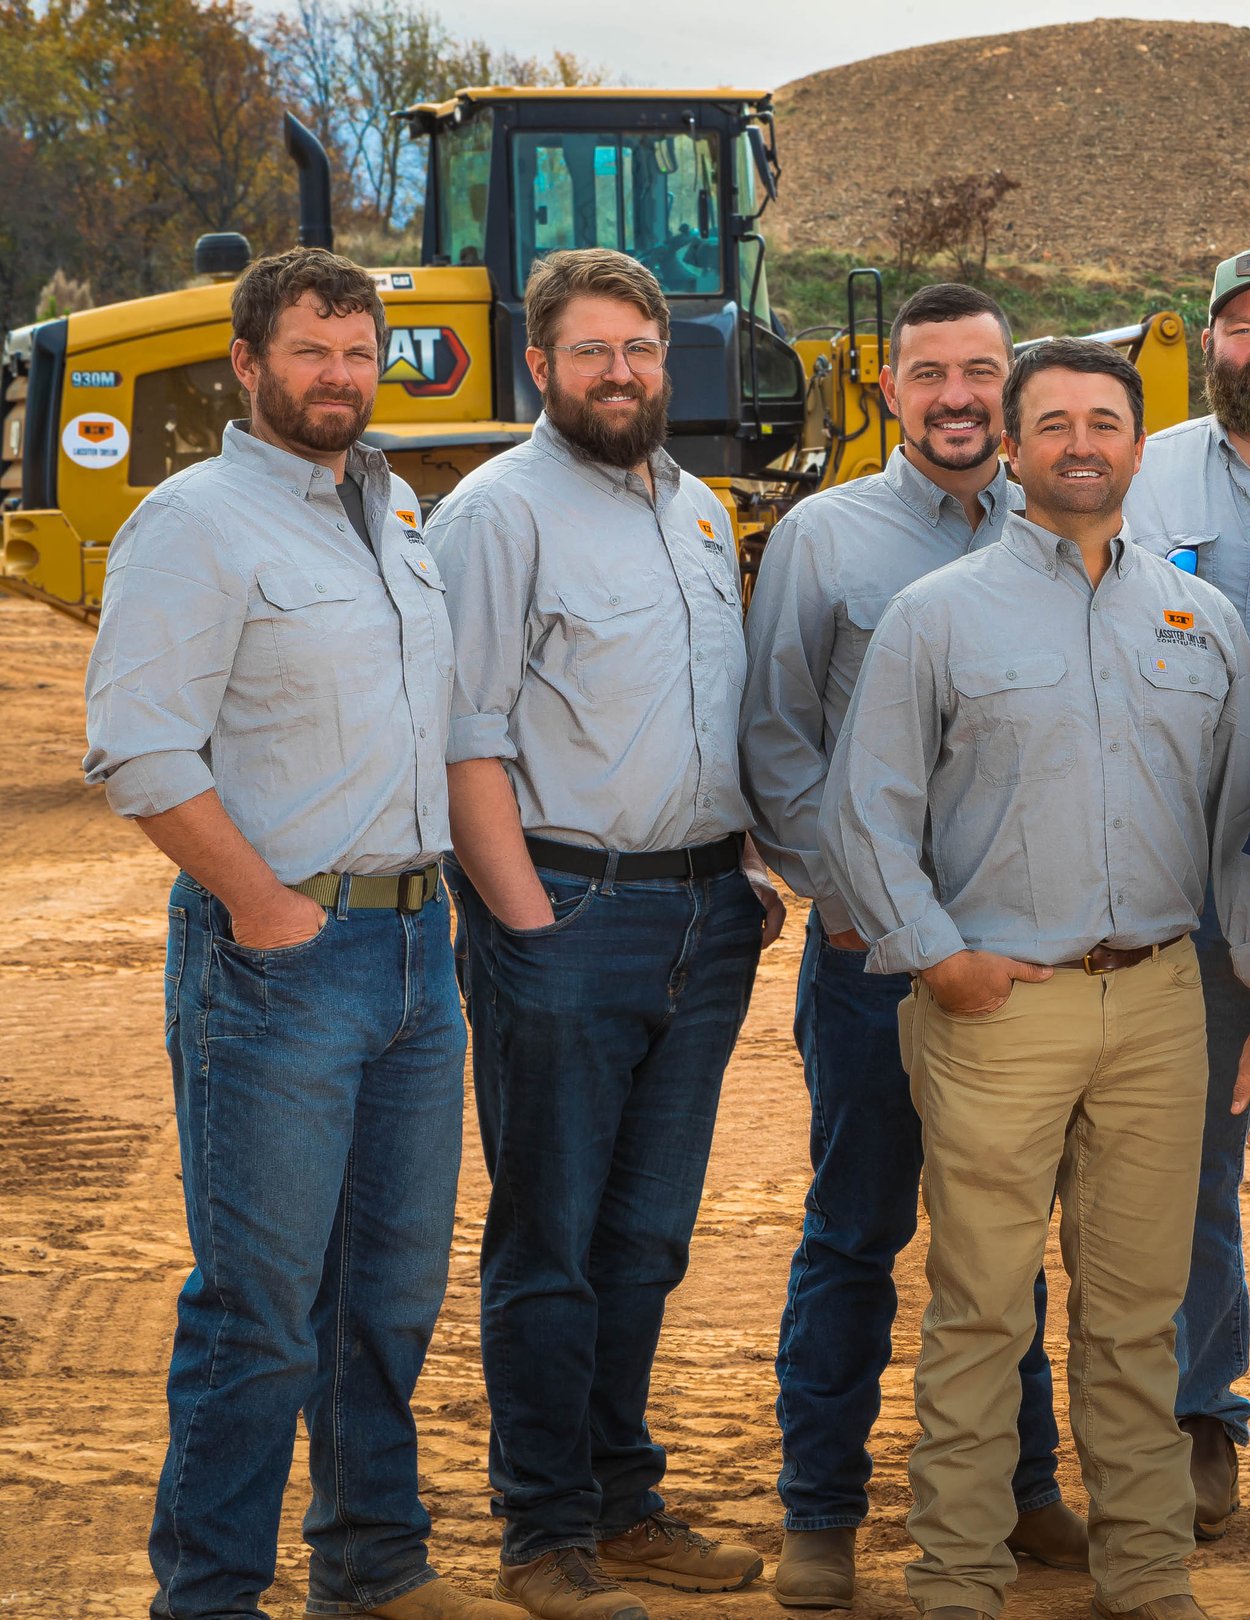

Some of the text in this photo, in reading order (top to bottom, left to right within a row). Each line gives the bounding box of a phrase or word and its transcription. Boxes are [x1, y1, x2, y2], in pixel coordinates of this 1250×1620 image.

[386, 328, 442, 381] AT
[72, 371, 116, 388] 930M
[1167, 614, 1190, 625] LT
[1154, 628, 1207, 646] LASSITER TAYLOR
